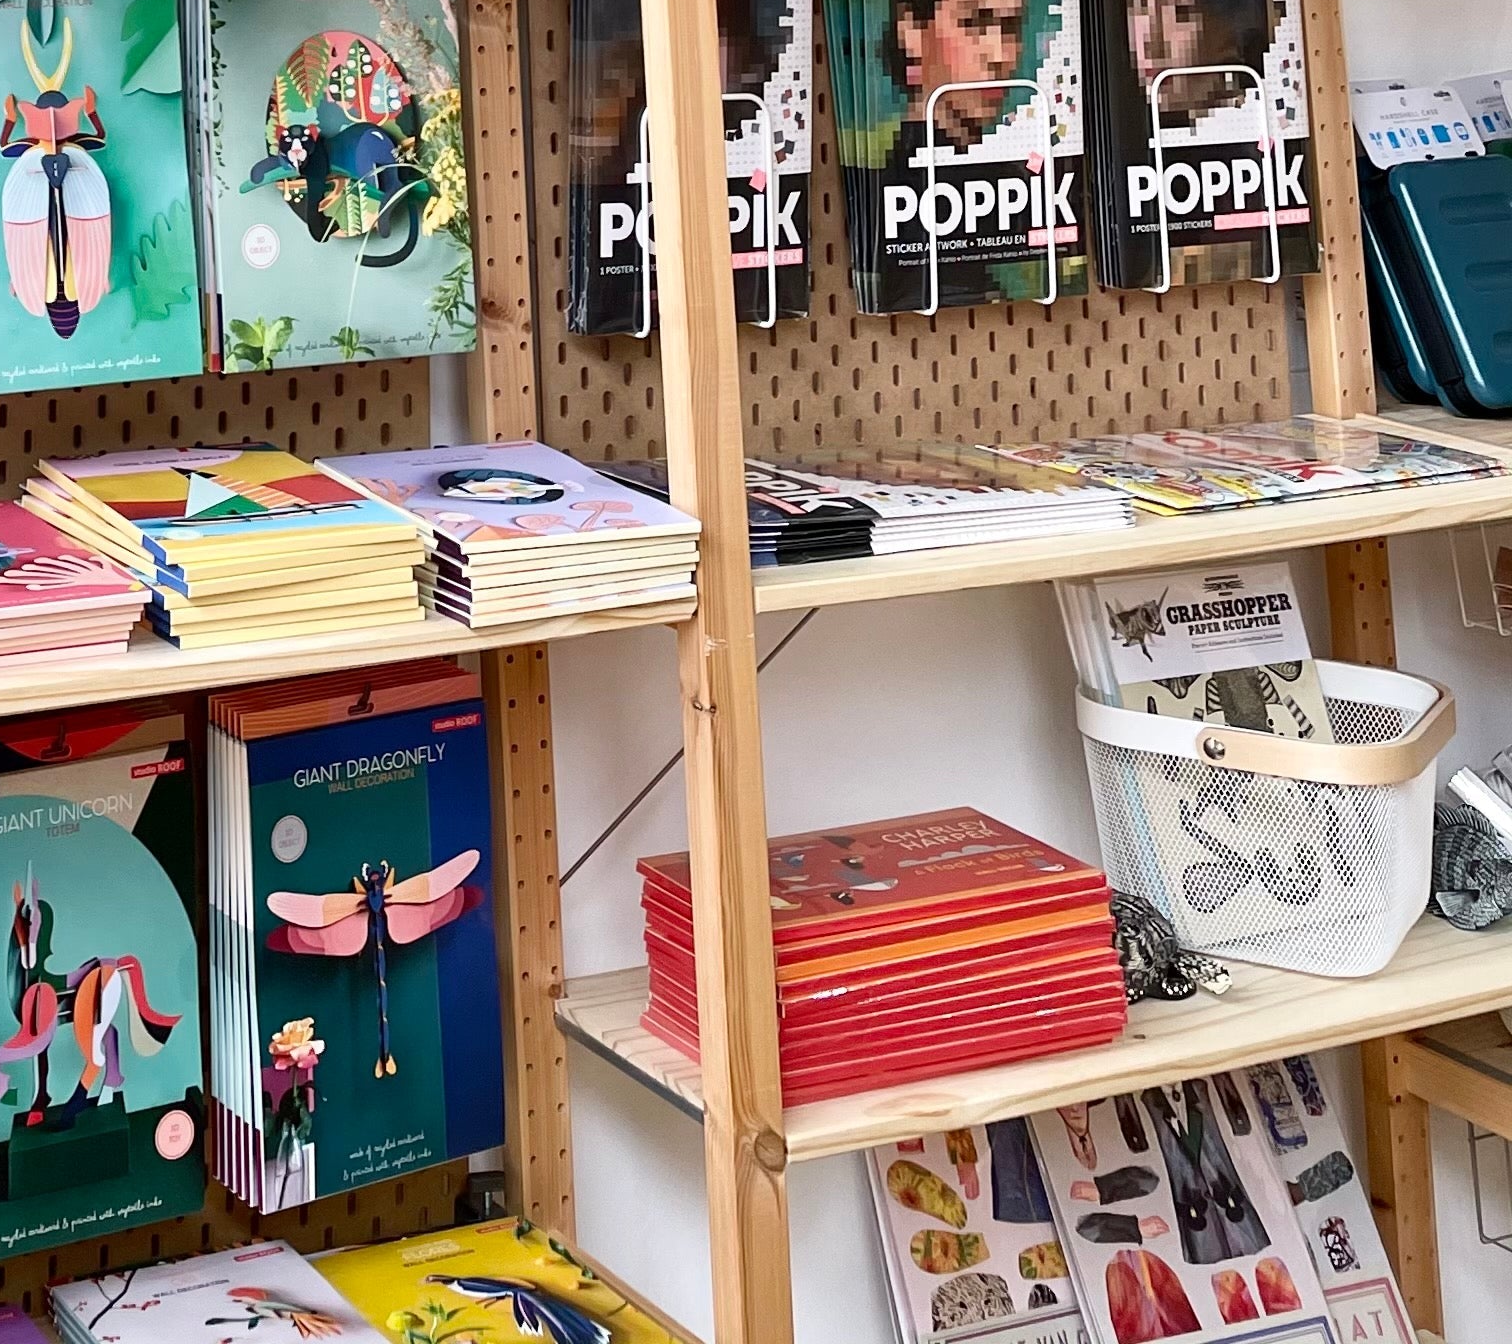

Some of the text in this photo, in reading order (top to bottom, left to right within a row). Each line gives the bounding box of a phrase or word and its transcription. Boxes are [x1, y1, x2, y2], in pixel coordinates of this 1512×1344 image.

[883, 172, 1078, 239] POPPIK
[600, 191, 802, 258] PPIK
[885, 242, 924, 255] STICKER
[924, 240, 968, 252] ATWORK
[976, 236, 1013, 247] TABLEAU
[1014, 234, 1026, 244] EN
[605, 265, 635, 275] POSTER
[1166, 593, 1292, 624] GRASSHOPPER
[1188, 614, 1281, 636] PAPER SCULPTURE
[456, 715, 478, 727] ROOF
[157, 760, 183, 772] ROOF
[293, 743, 446, 789] GIANT DRAGONFLY
[328, 768, 415, 794] WALL DECORATION
[49, 793, 133, 825] UNICORN
[881, 819, 990, 844] CHARLEY
[899, 829, 1002, 851] HARPER
[994, 849, 1045, 862] Birds
